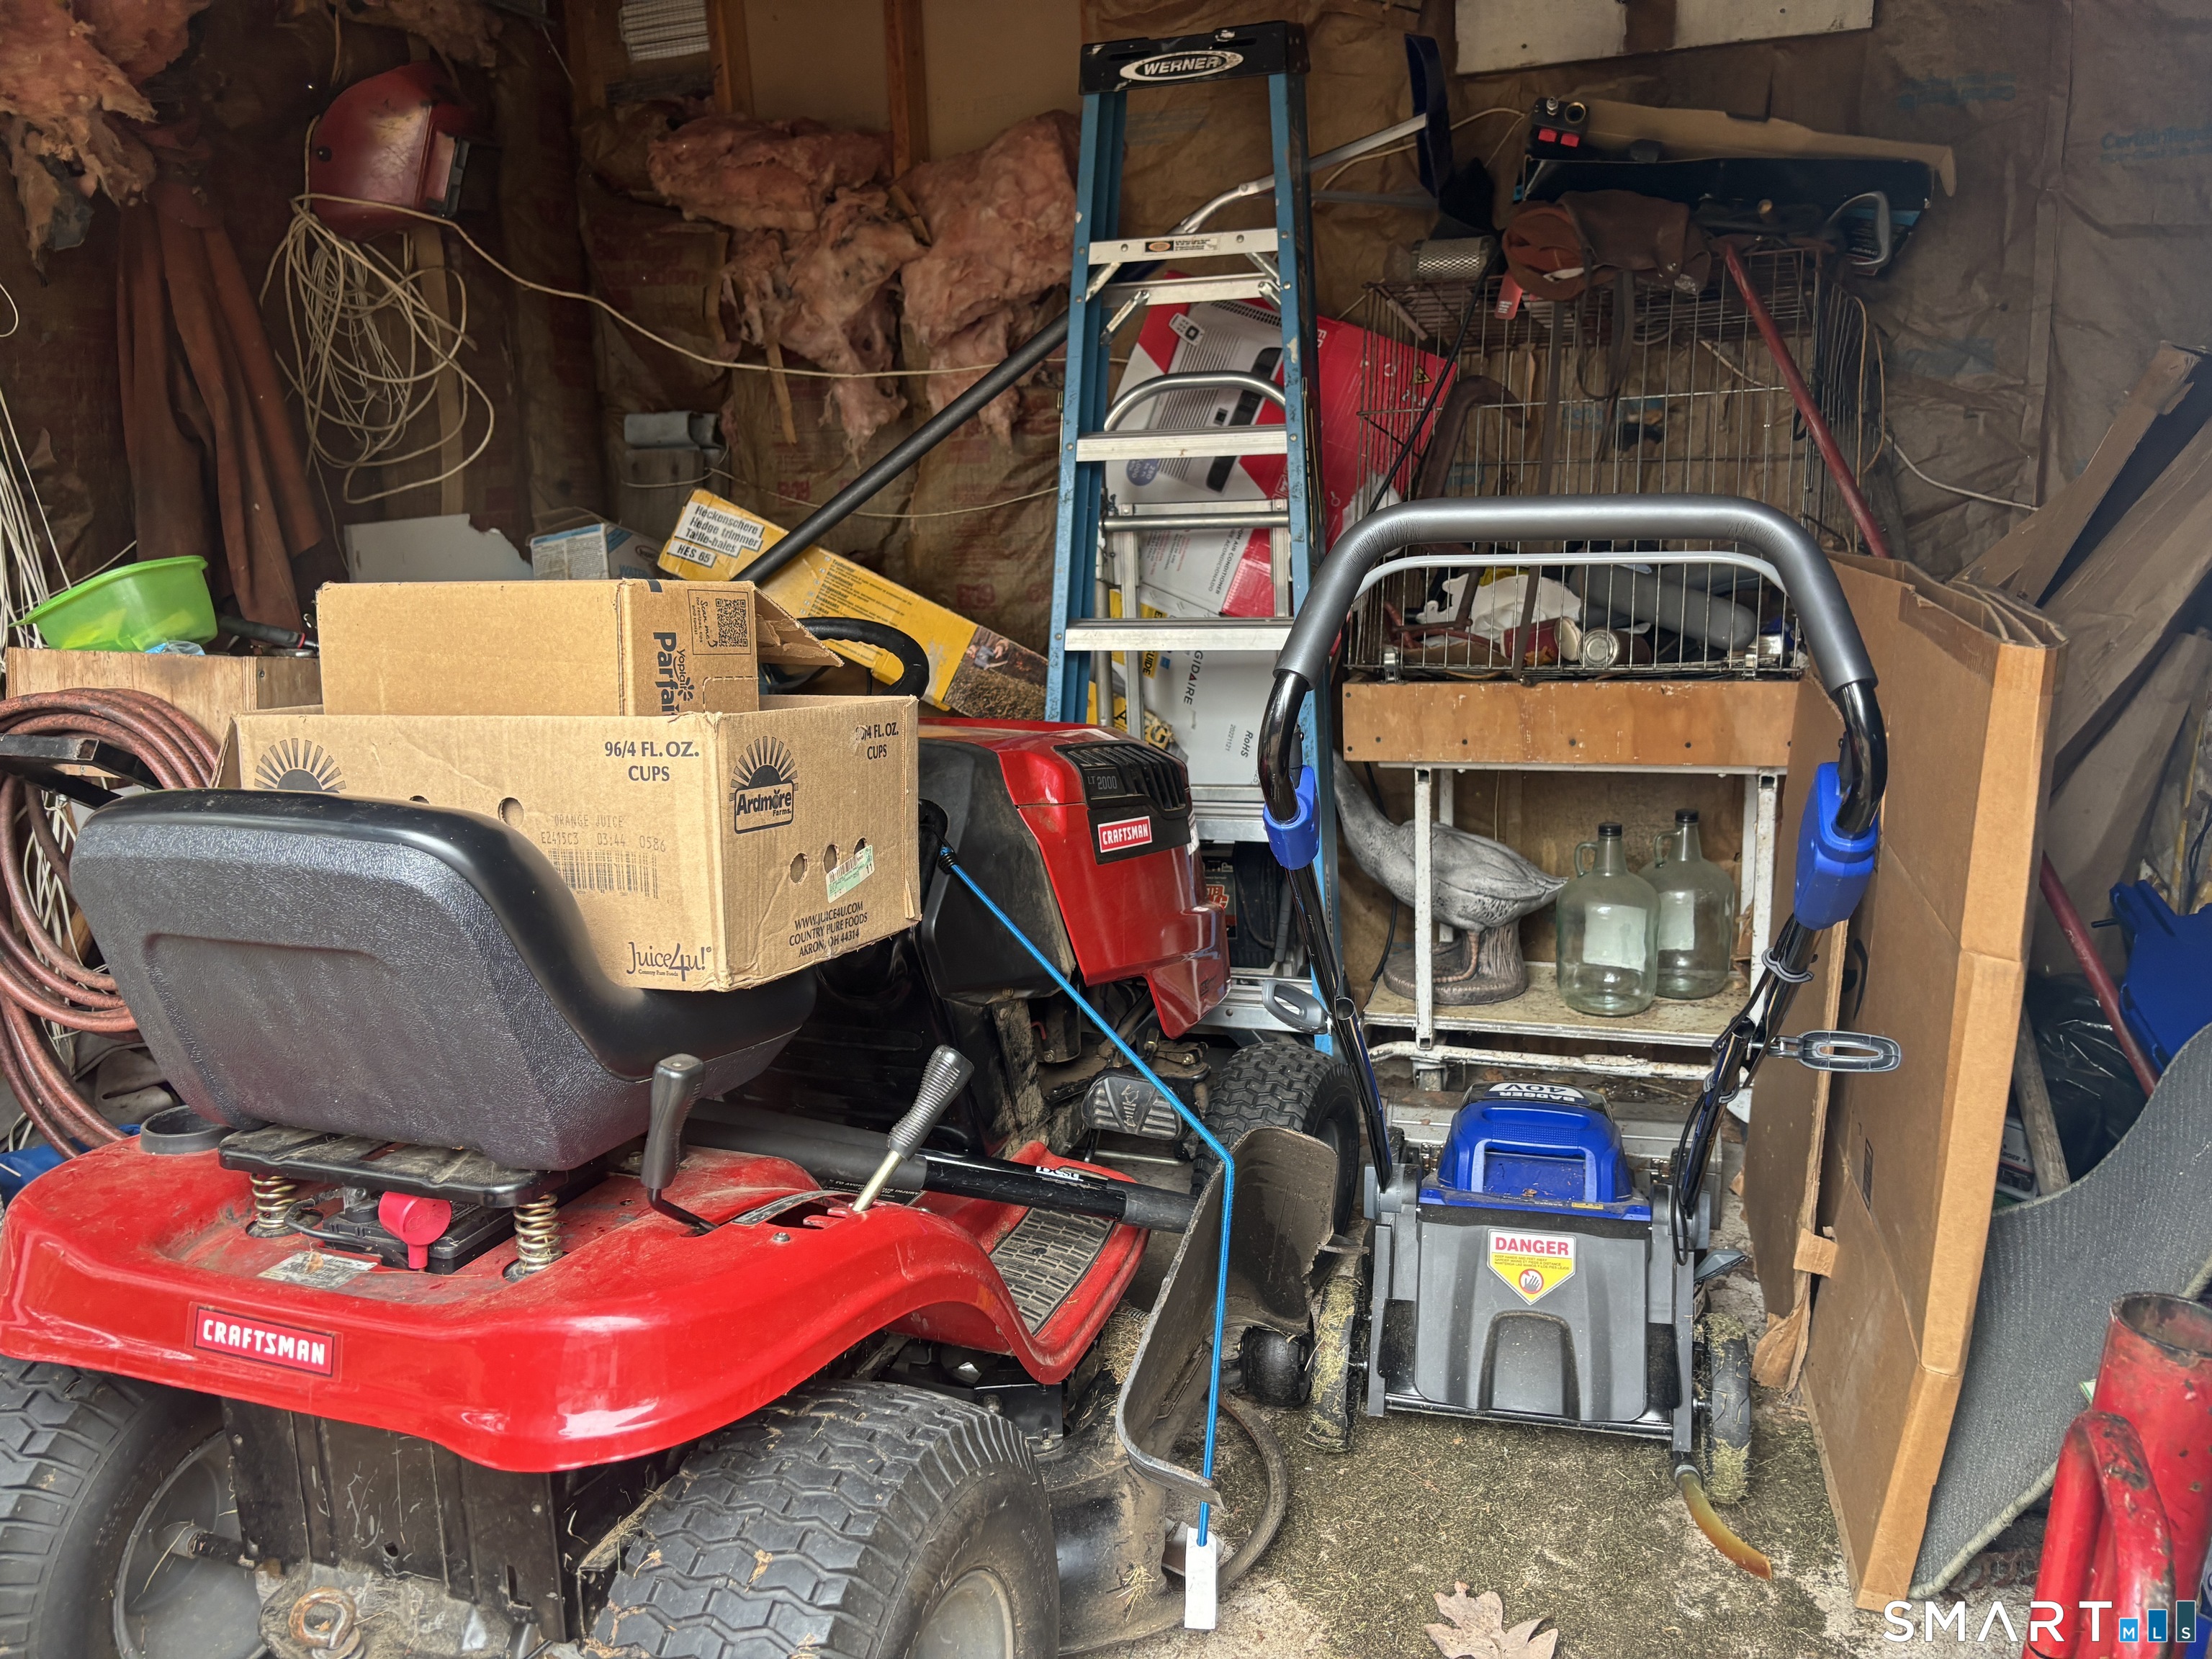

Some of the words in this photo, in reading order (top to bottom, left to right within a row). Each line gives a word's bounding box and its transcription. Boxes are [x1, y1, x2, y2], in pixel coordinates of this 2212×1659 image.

[1144, 57, 1220, 76] WERNER
[695, 505, 758, 535] Heckenschere
[690, 516, 719, 534] Hedge
[721, 528, 759, 547] trimmer
[677, 544, 697, 558] HES
[698, 552, 711, 562] 65
[1208, 539, 1230, 592] ACONDICIONADO
[1215, 552, 1233, 595] CONDITIONER
[704, 625, 710, 639] me
[653, 632, 680, 713] Parfai
[873, 724, 884, 738] FL.
[885, 721, 899, 737] OZ.
[1225, 724, 1236, 752] 20221121
[604, 740, 636, 758] 96/4
[642, 742, 663, 757] FL.
[666, 741, 699, 757] OZ.
[867, 744, 887, 760] CUPS
[1240, 730, 1254, 758] RoHS
[628, 765, 670, 781] CUPS
[1087, 776, 1095, 785] LT
[1097, 775, 1118, 790] 2000
[736, 790, 791, 815] Ardmore
[554, 814, 588, 827] ORANGE
[595, 815, 624, 828] JUICE
[597, 832, 626, 846] 03:44
[639, 835, 666, 853] 0586
[1102, 823, 1148, 845] CRAFTSMAN
[794, 901, 863, 930] WWW.JUICE4U.COM
[789, 926, 824, 946] COUNTRY
[826, 920, 843, 935] PURE
[845, 912, 868, 928] FOODS
[799, 939, 826, 958] AKRON,
[828, 936, 840, 948] OH
[840, 928, 859, 943] 44314
[1499, 1092, 1575, 1102] BADGER
[1504, 1084, 1566, 1093] 40V
[1496, 1237, 1569, 1255] DANGER
[202, 1319, 325, 1365] CRAFTSMAN
